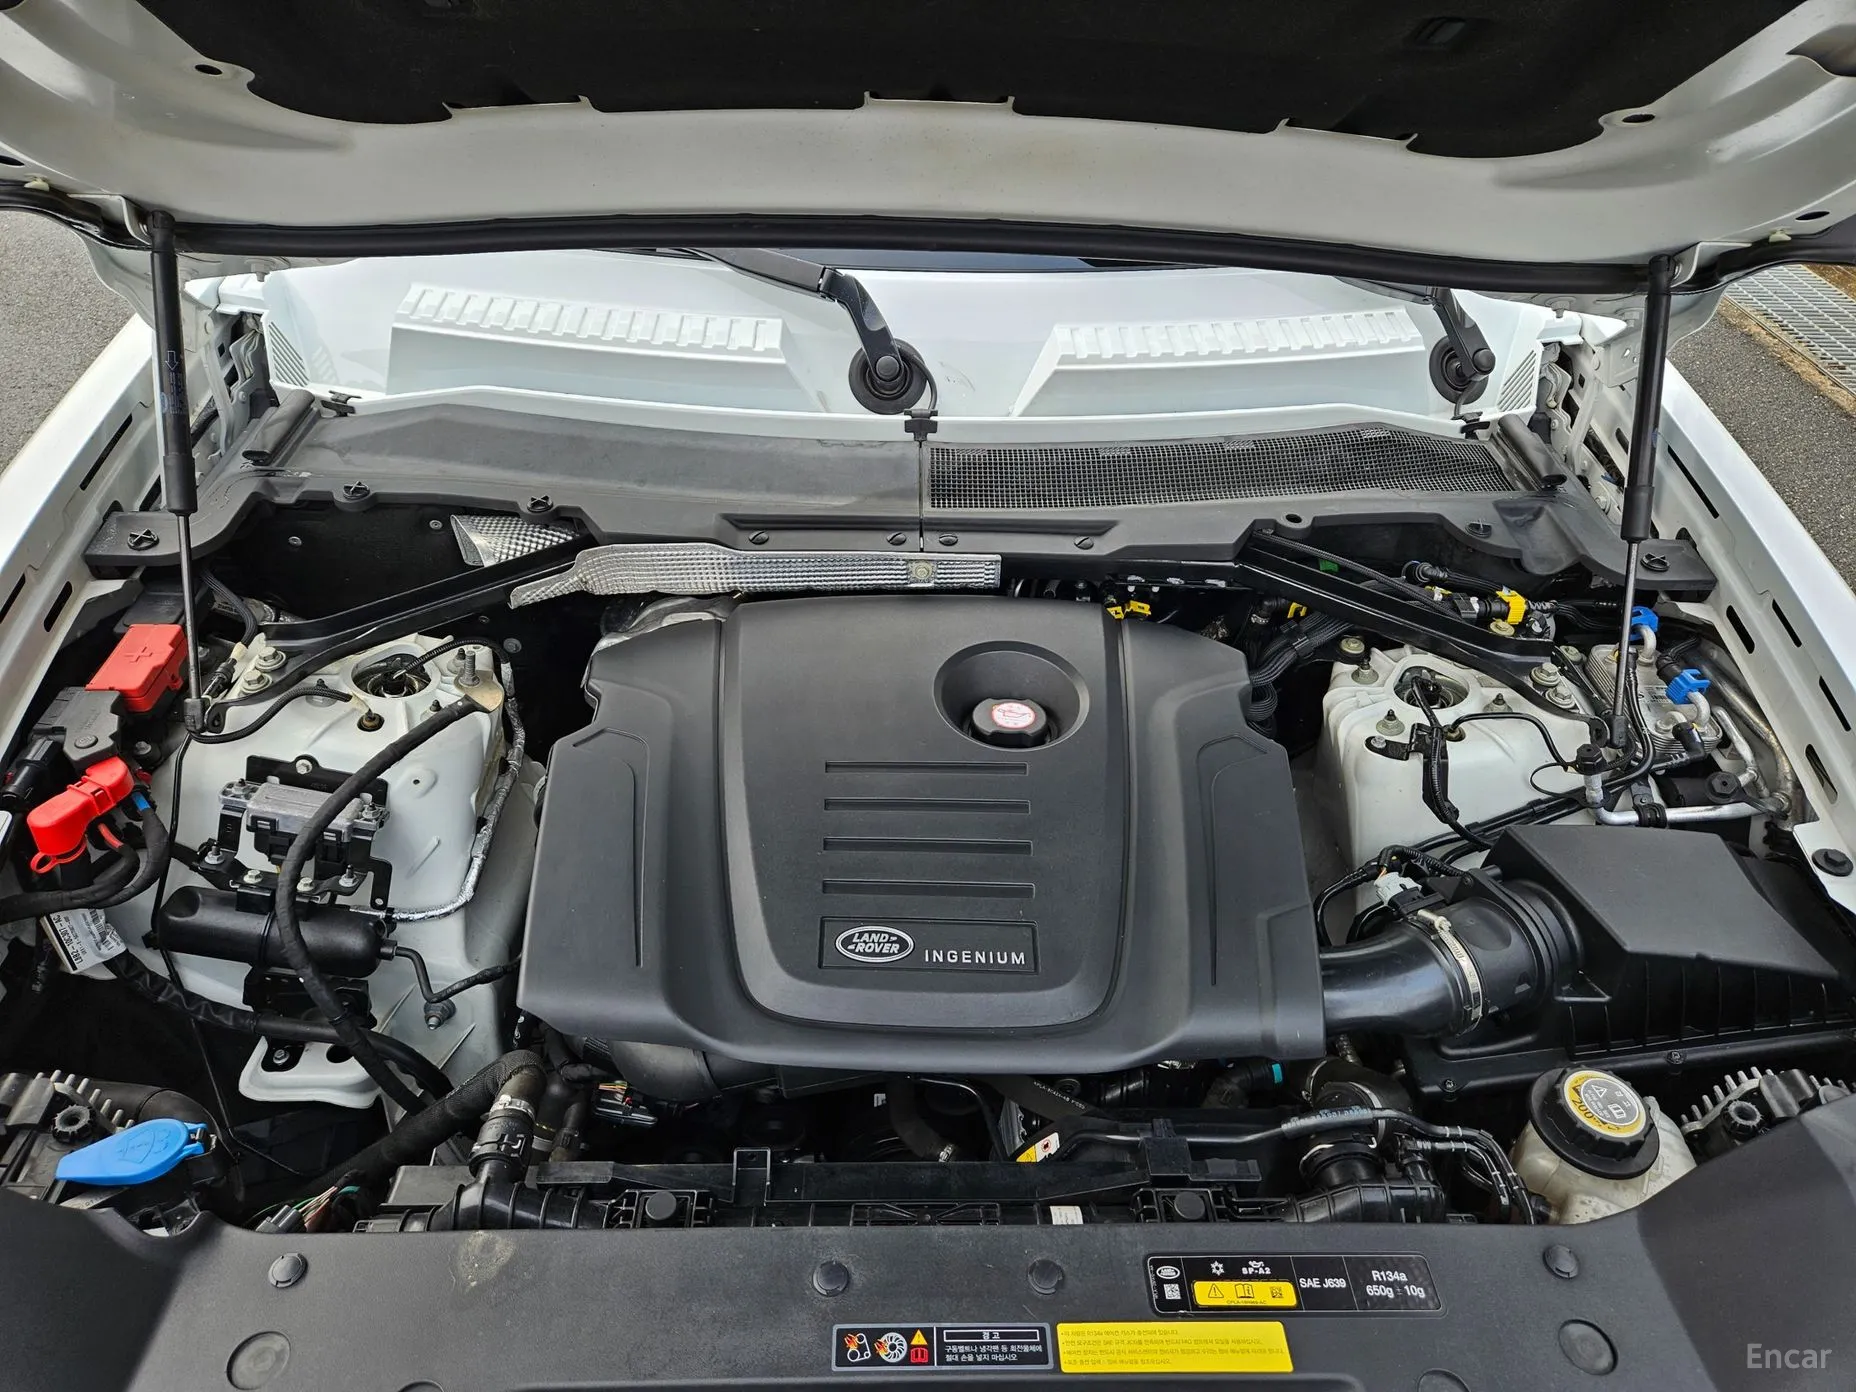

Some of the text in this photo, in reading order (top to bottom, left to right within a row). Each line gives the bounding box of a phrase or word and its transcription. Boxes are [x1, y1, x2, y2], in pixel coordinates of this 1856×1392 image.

[852, 933, 889, 943] LAND
[854, 943, 900, 953] ROVER
[925, 949, 1025, 965] INGENIUM
[1371, 1270, 1408, 1282] R134a
[1299, 1278, 1347, 1288] SAE J639
[1366, 1284, 1395, 1298] 650g
[1404, 1285, 1426, 1298] 10g
[960, 1354, 974, 1362] 손을
[991, 1353, 1018, 1361] 마십시오
